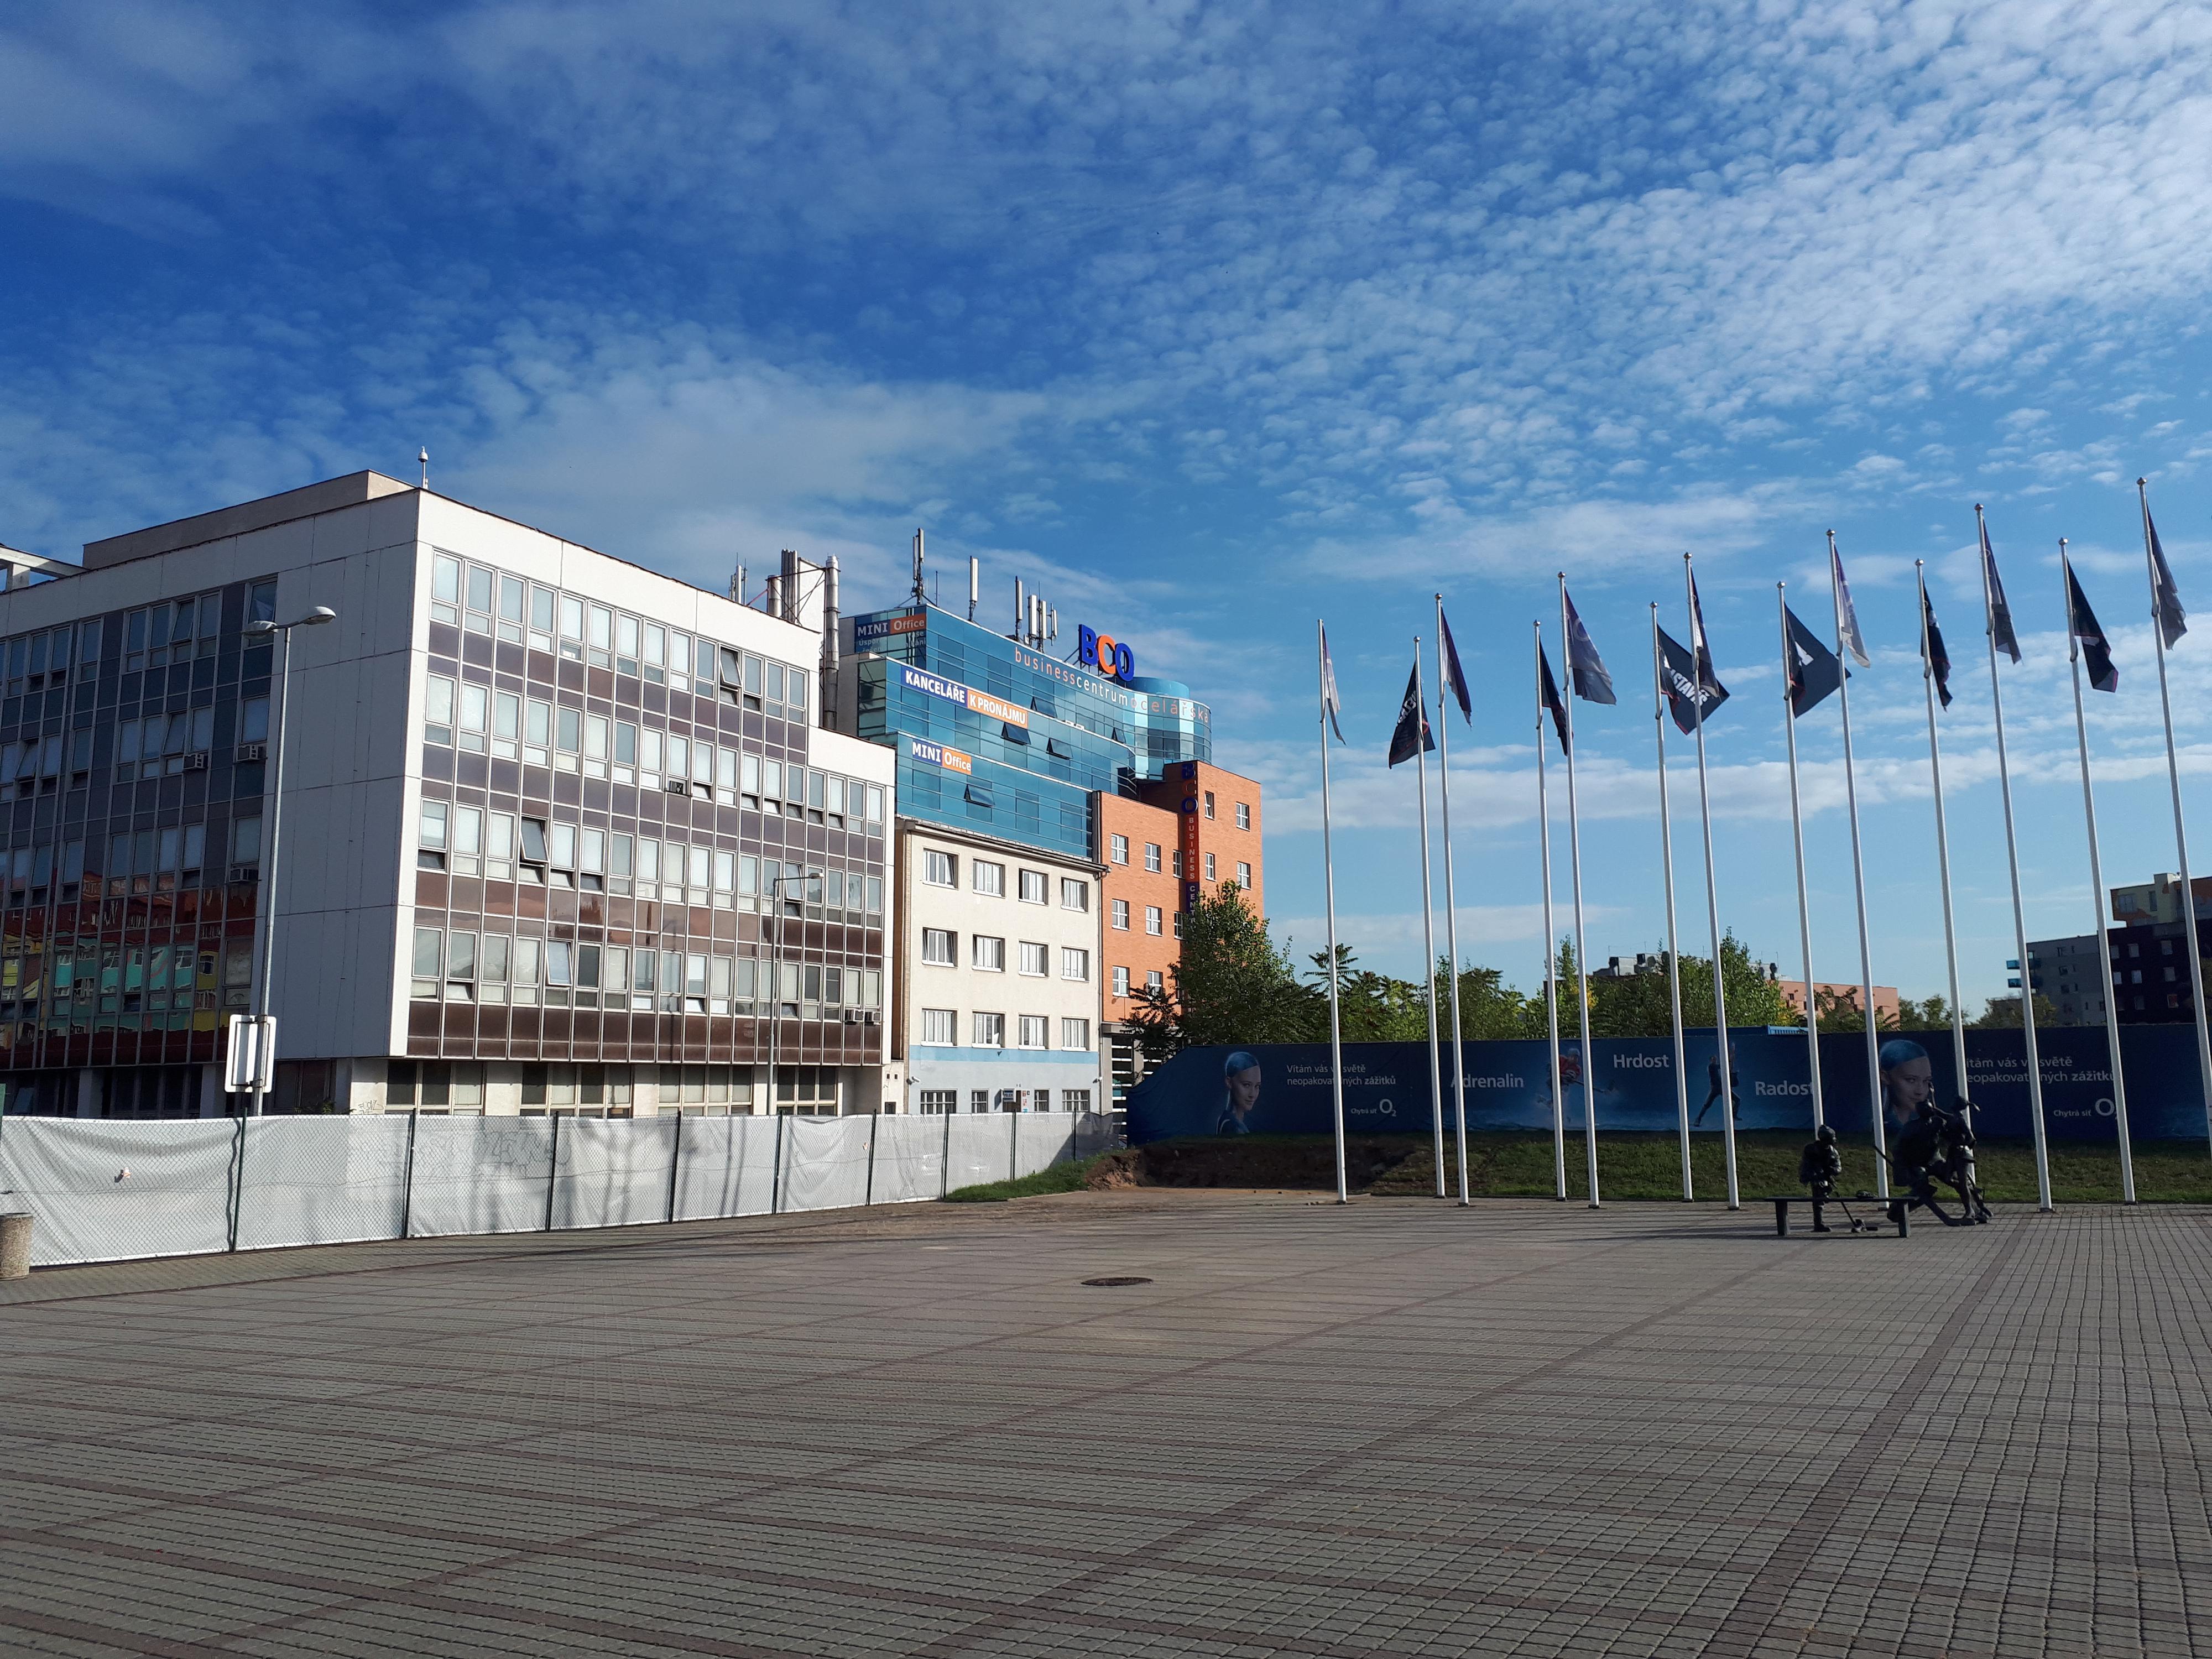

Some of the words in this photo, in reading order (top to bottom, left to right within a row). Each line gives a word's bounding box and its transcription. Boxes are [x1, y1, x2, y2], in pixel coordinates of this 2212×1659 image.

[858, 622, 888, 637] MINI
[894, 620, 925, 630] Office
[1079, 624, 1135, 681] BCO
[906, 670, 965, 703] KANCELÁŘE
[970, 694, 977, 708] K
[978, 698, 1025, 724] PRONÁJMU
[912, 742, 941, 763] MINI
[945, 752, 971, 771] Office
[1182, 763, 1198, 813] BCO
[1287, 1065, 1312, 1073] Vítám
[1314, 1064, 1328, 1073] vás
[1343, 1064, 1366, 1073] světě
[1613, 1053, 1669, 1068] Hrdost
[1966, 1058, 1994, 1068] ítám
[1997, 1057, 2017, 1067] vás
[2039, 1056, 2073, 1067] světě
[1364, 1076, 1396, 1085] zážitků
[2053, 1109, 2079, 1118] Chytrá
